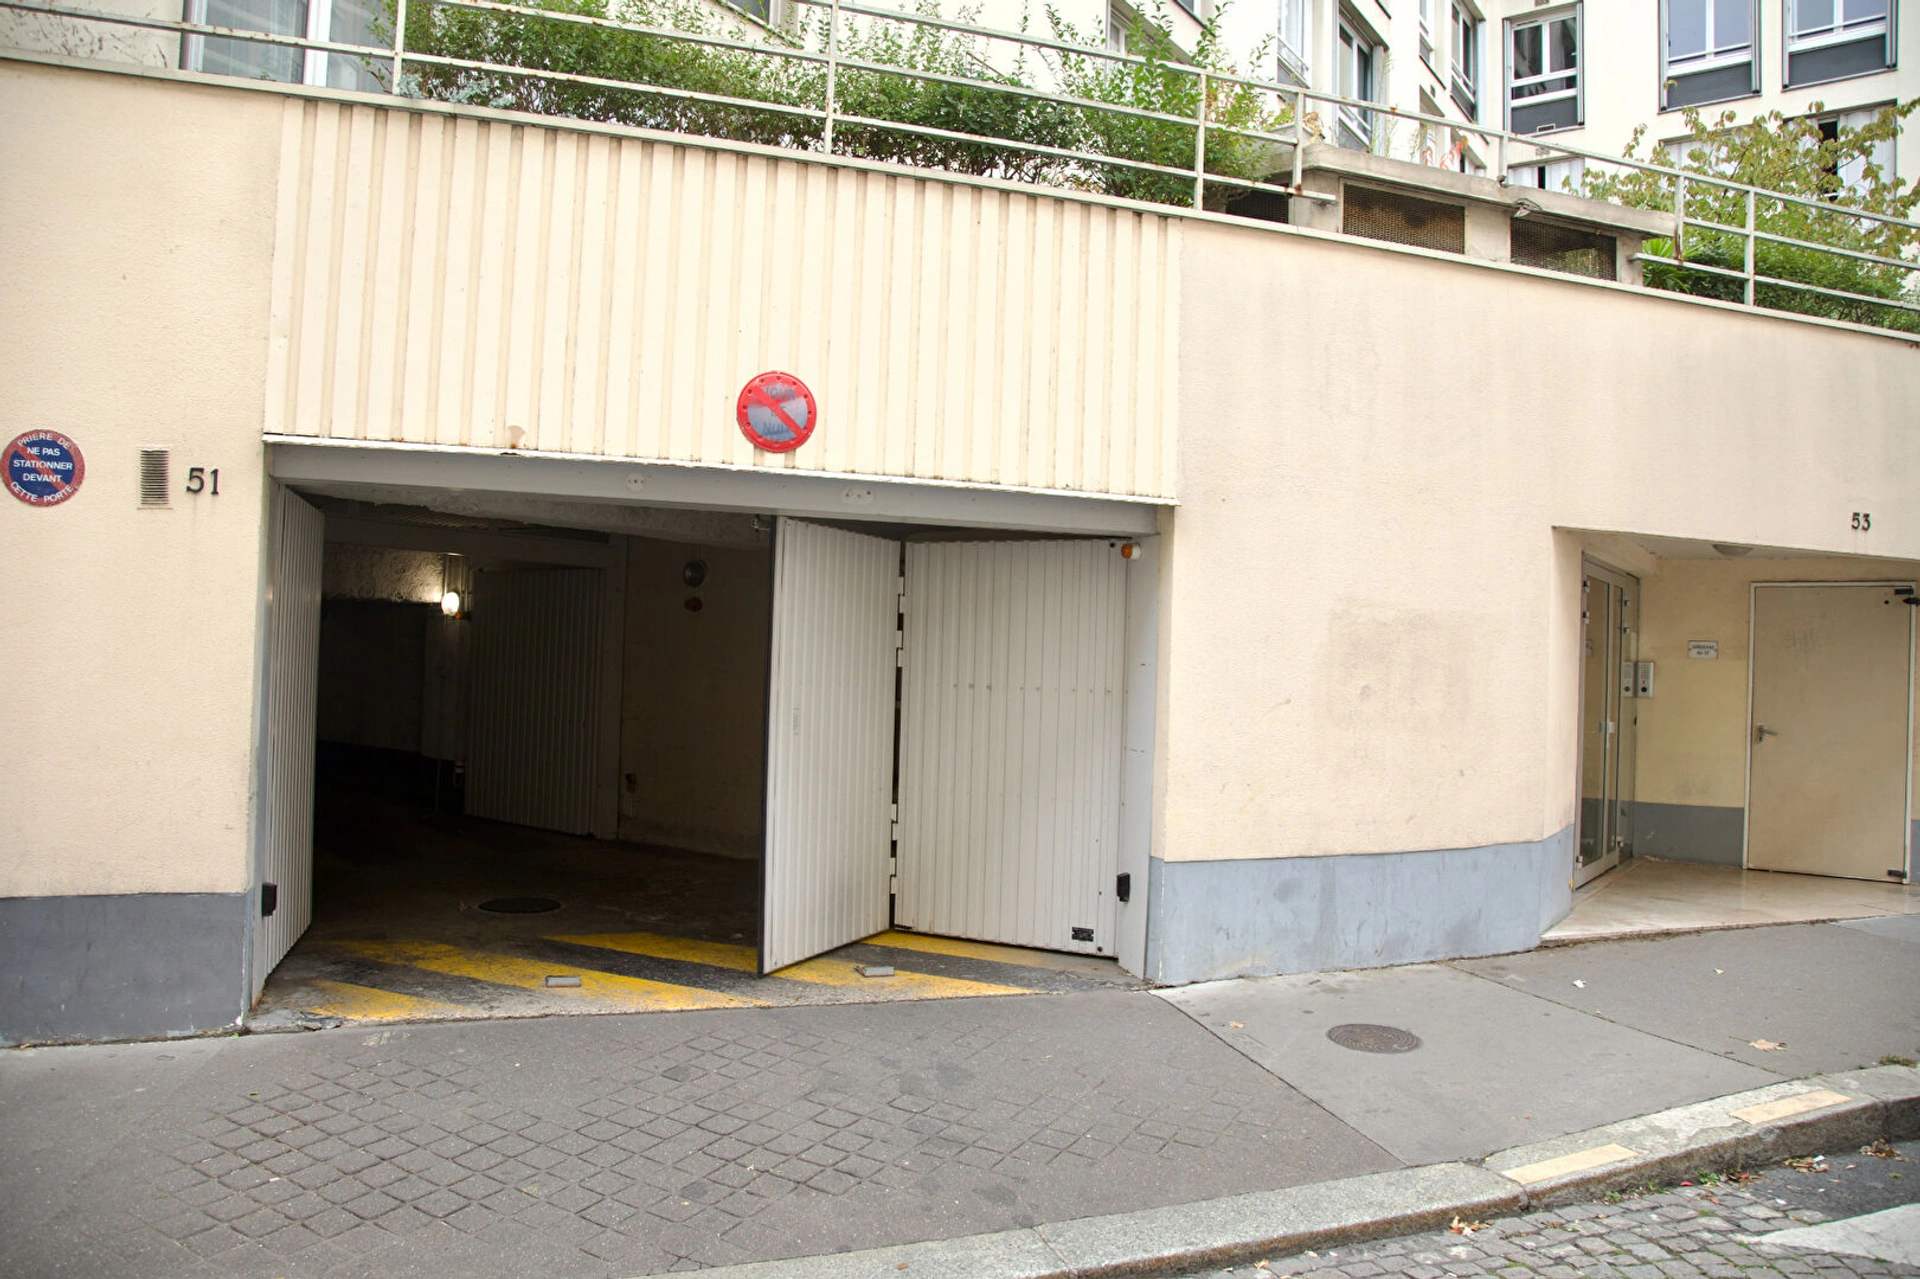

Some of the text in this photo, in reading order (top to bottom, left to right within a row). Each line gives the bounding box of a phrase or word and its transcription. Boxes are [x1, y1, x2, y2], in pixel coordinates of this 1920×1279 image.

[57, 437, 71, 450] DE
[27, 447, 61, 456] NE PAS
[13, 459, 73, 470] STATIONNER
[22, 473, 62, 482] DEVANT
[185, 467, 219, 495] 51
[10, 481, 38, 502] CETTE
[1851, 512, 1871, 532] 53
